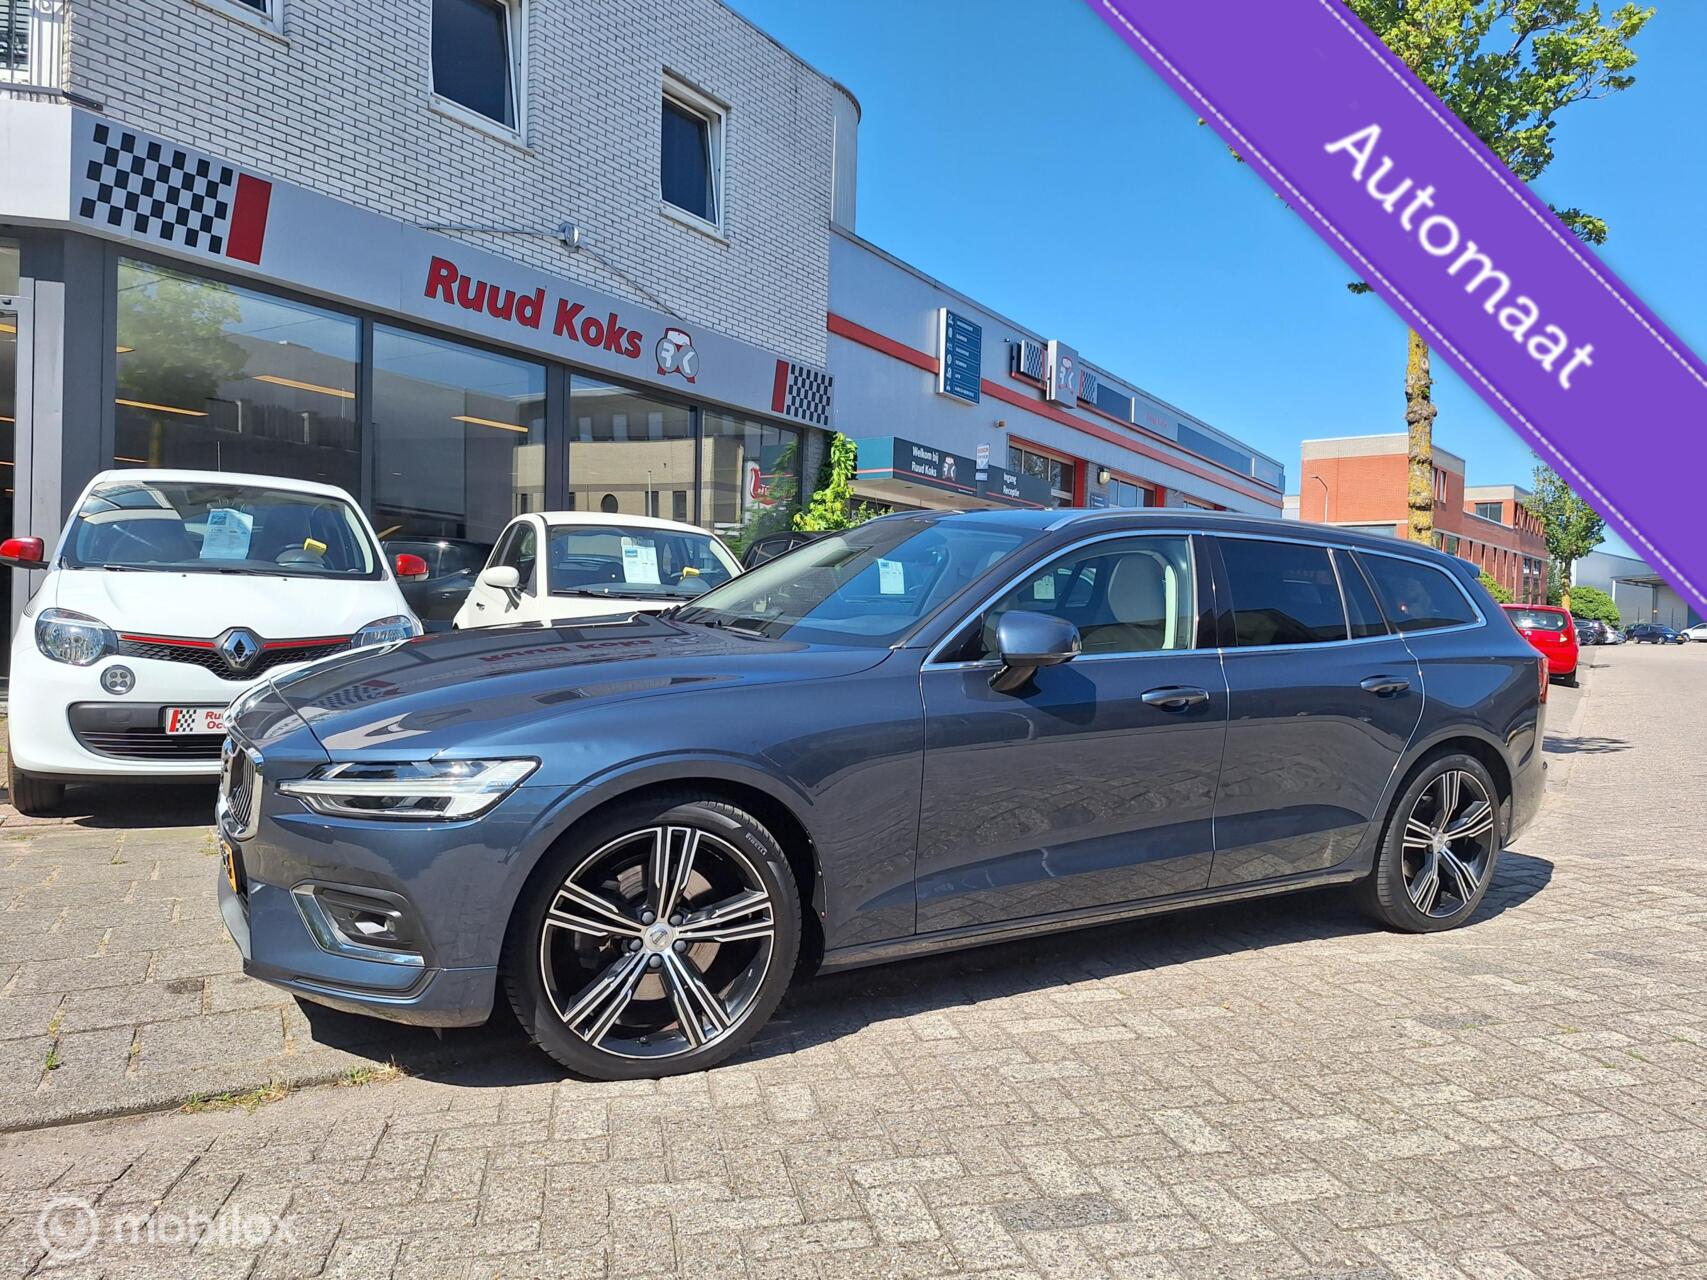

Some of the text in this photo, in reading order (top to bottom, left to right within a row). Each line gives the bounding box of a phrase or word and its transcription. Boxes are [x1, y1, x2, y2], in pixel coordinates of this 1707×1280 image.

[424, 255, 643, 359] Ruud Koks
[912, 445, 932, 460] Welkom
[911, 460, 937, 477] Ruud Koks
[205, 711, 225, 720] Ru
